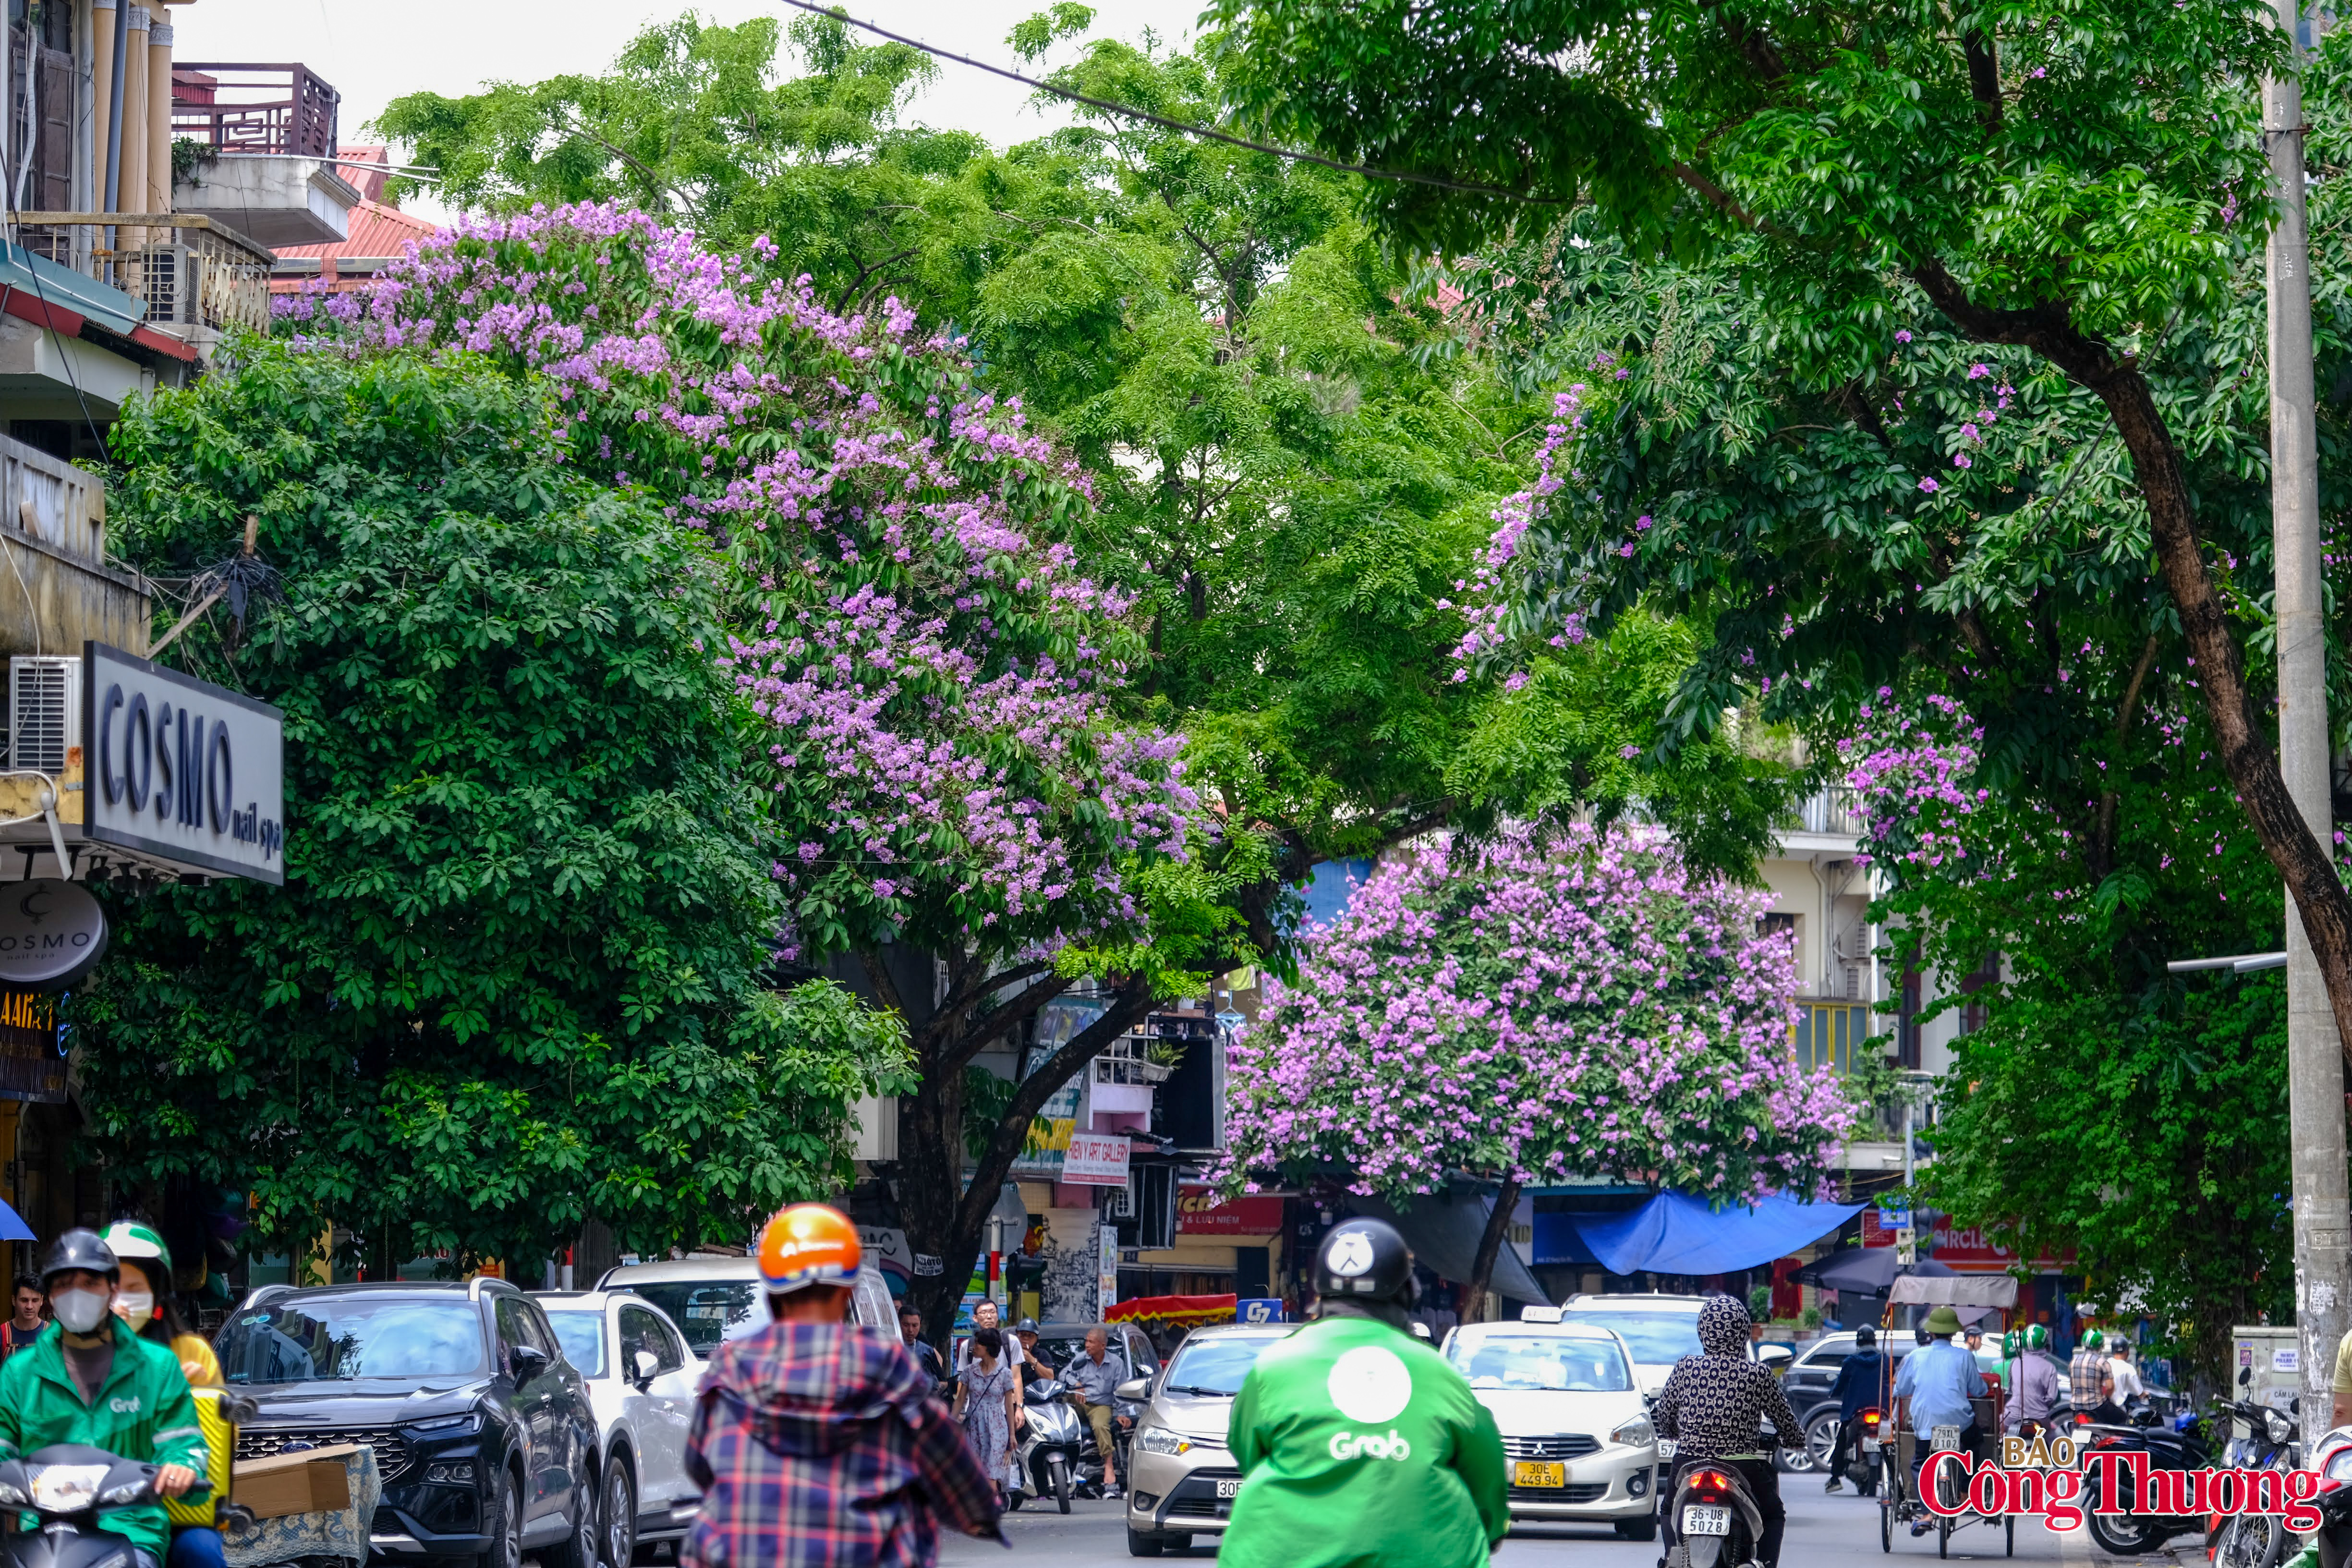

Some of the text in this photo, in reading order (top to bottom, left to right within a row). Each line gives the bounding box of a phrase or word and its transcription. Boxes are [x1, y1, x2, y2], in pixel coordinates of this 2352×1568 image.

[101, 683, 232, 834] COSMO
[233, 802, 280, 860] nail spa
[1066, 1141, 1083, 1160] HIEN
[1089, 1142, 1102, 1162] ART
[1103, 1143, 1129, 1163] GALLERY
[1247, 1301, 1271, 1324] G7
[1329, 1429, 1410, 1461] Grab
[1529, 1464, 1550, 1474] 30E
[1520, 1475, 1559, 1486] 449.94
[1691, 1509, 1723, 1520] 36-U8
[1690, 1520, 1722, 1533] 5028
